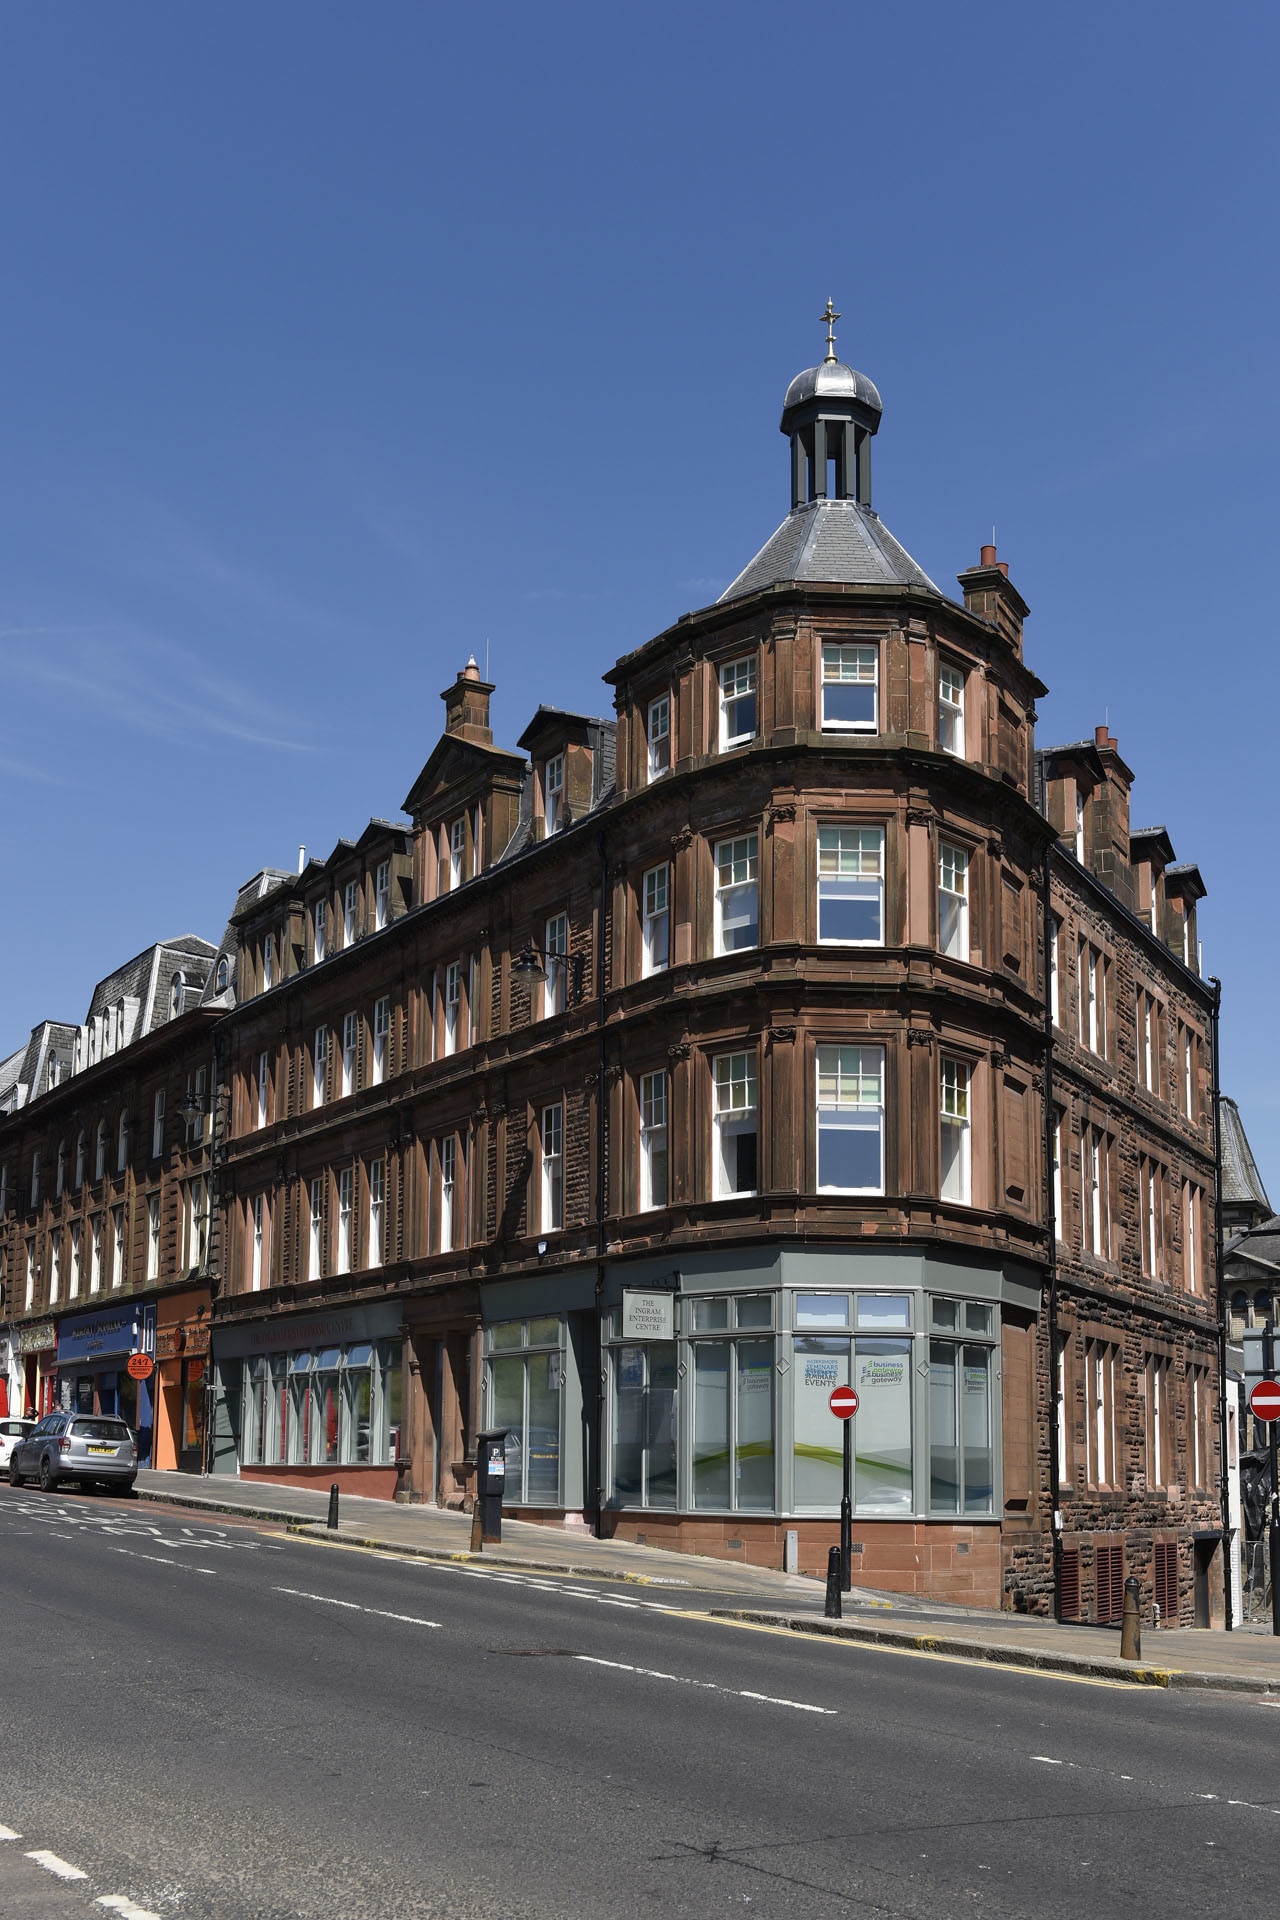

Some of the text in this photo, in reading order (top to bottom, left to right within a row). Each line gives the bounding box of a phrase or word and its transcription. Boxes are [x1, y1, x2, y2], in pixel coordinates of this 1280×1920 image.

[642, 1299, 655, 1307] THE
[635, 1307, 661, 1315] INGRAM
[629, 1315, 667, 1323] ENTERPRISE
[805, 1379, 837, 1387] EVENTS
[871, 1376, 904, 1384] gateway
[493, 1448, 499, 1456] P
